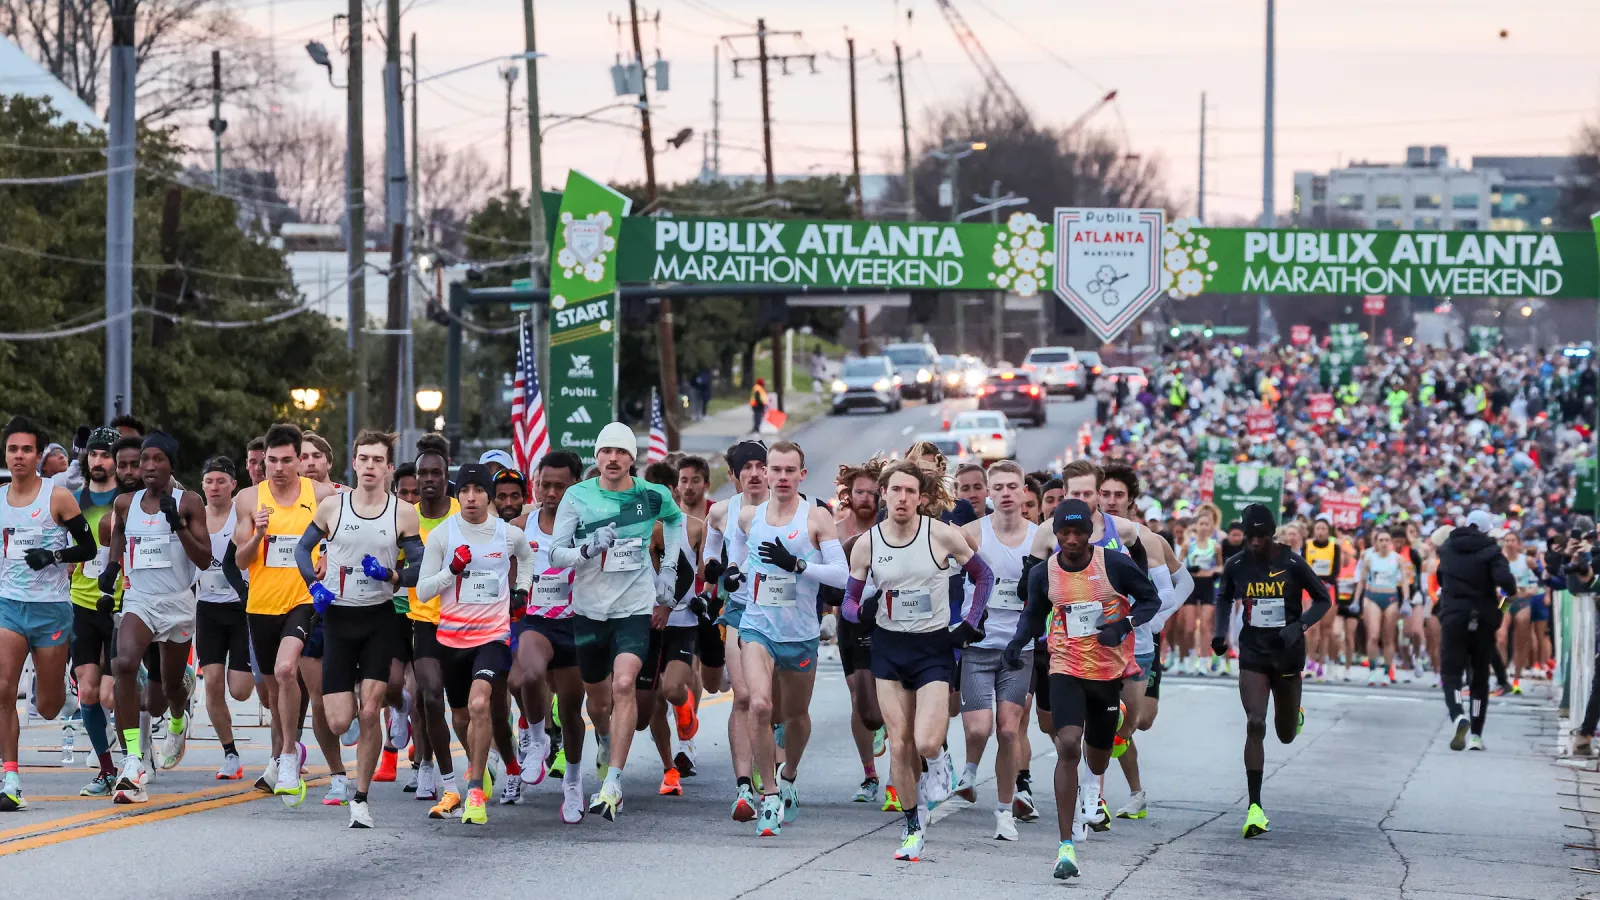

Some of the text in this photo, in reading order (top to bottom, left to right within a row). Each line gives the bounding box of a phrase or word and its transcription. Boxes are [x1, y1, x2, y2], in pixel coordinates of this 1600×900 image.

[1086, 211, 1133, 223] Publix
[655, 220, 964, 258] PUBLIX ATLANTA
[1074, 231, 1145, 243] ATLANTA
[1244, 231, 1564, 266] PUBLIX ATLANTA
[653, 254, 964, 286] MARATHON WEEKEND
[1242, 266, 1563, 296] MARATHON WEEKEND
[555, 300, 609, 329] START
[560, 386, 598, 397] Publix
[1246, 581, 1286, 597] ARMY
